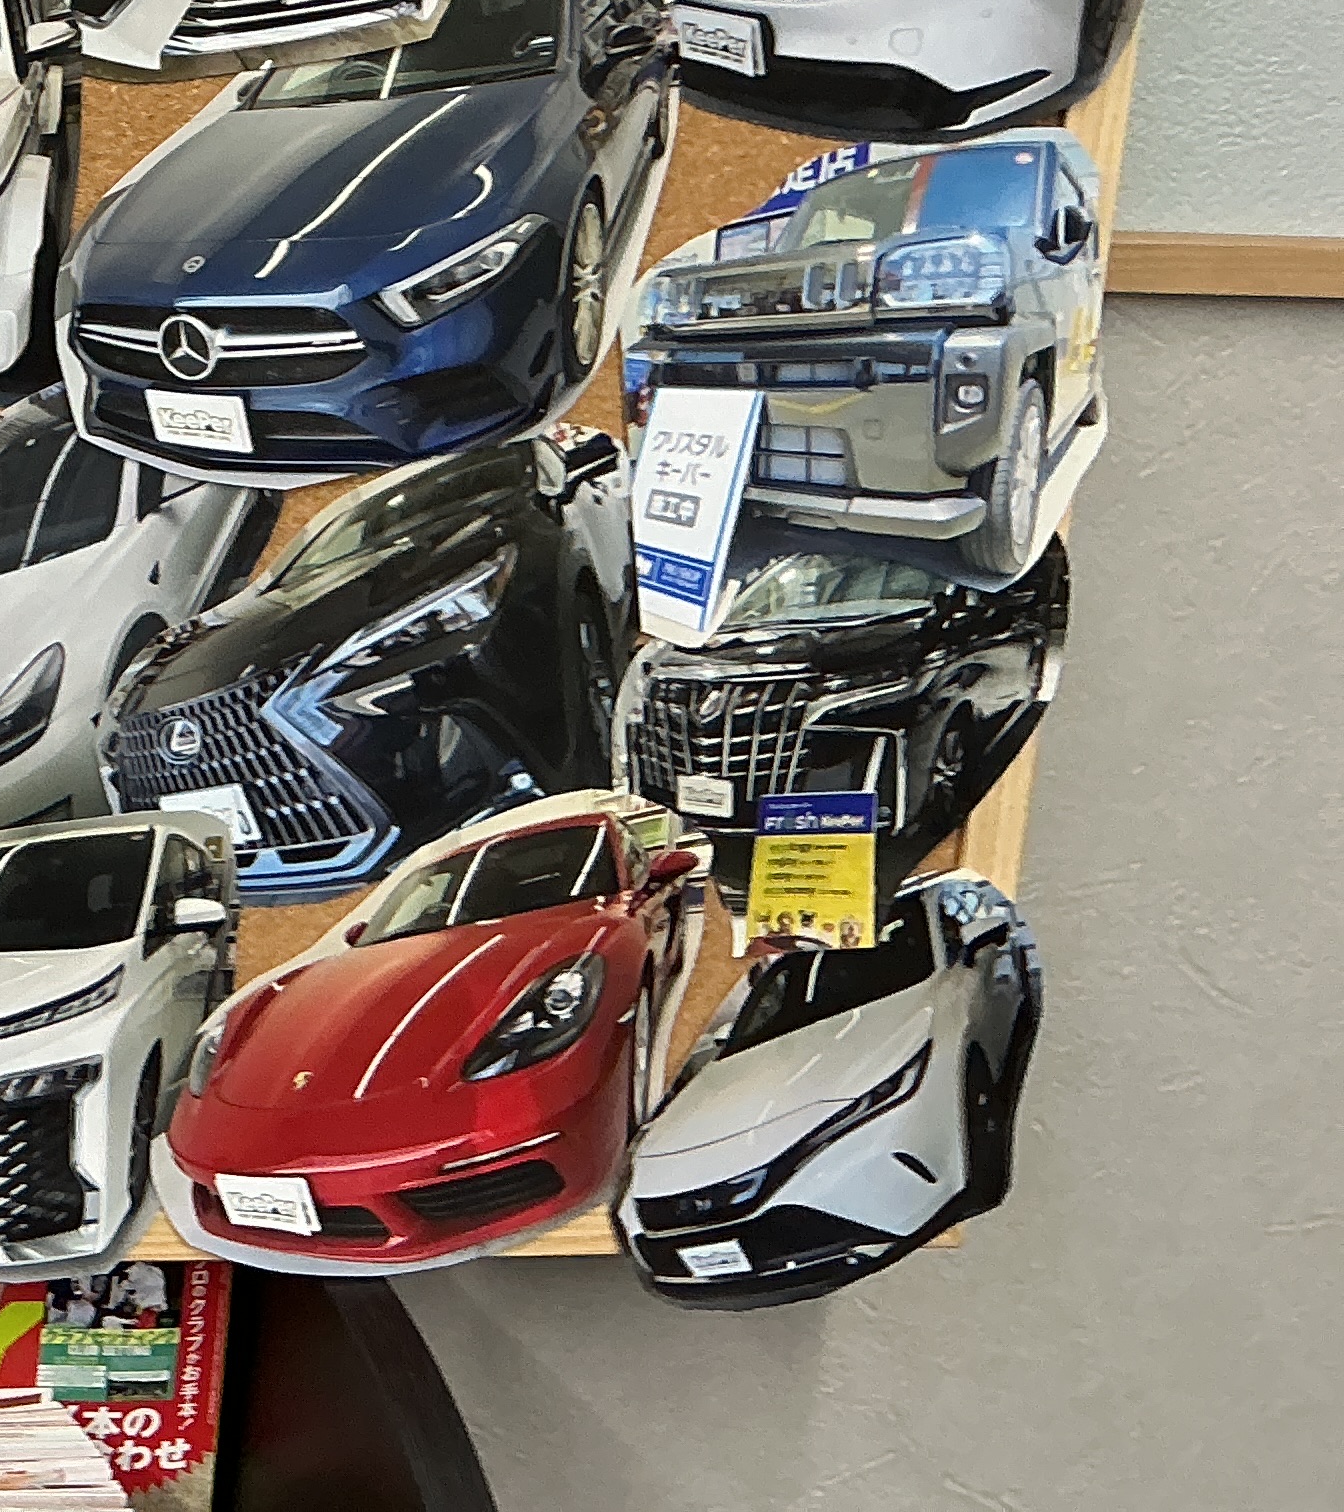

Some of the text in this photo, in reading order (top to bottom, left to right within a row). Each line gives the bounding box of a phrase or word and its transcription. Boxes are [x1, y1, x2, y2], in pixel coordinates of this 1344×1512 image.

[683, 21, 747, 58] KeePer
[156, 407, 234, 435] KeePer
[67, 1405, 162, 1439] 本の
